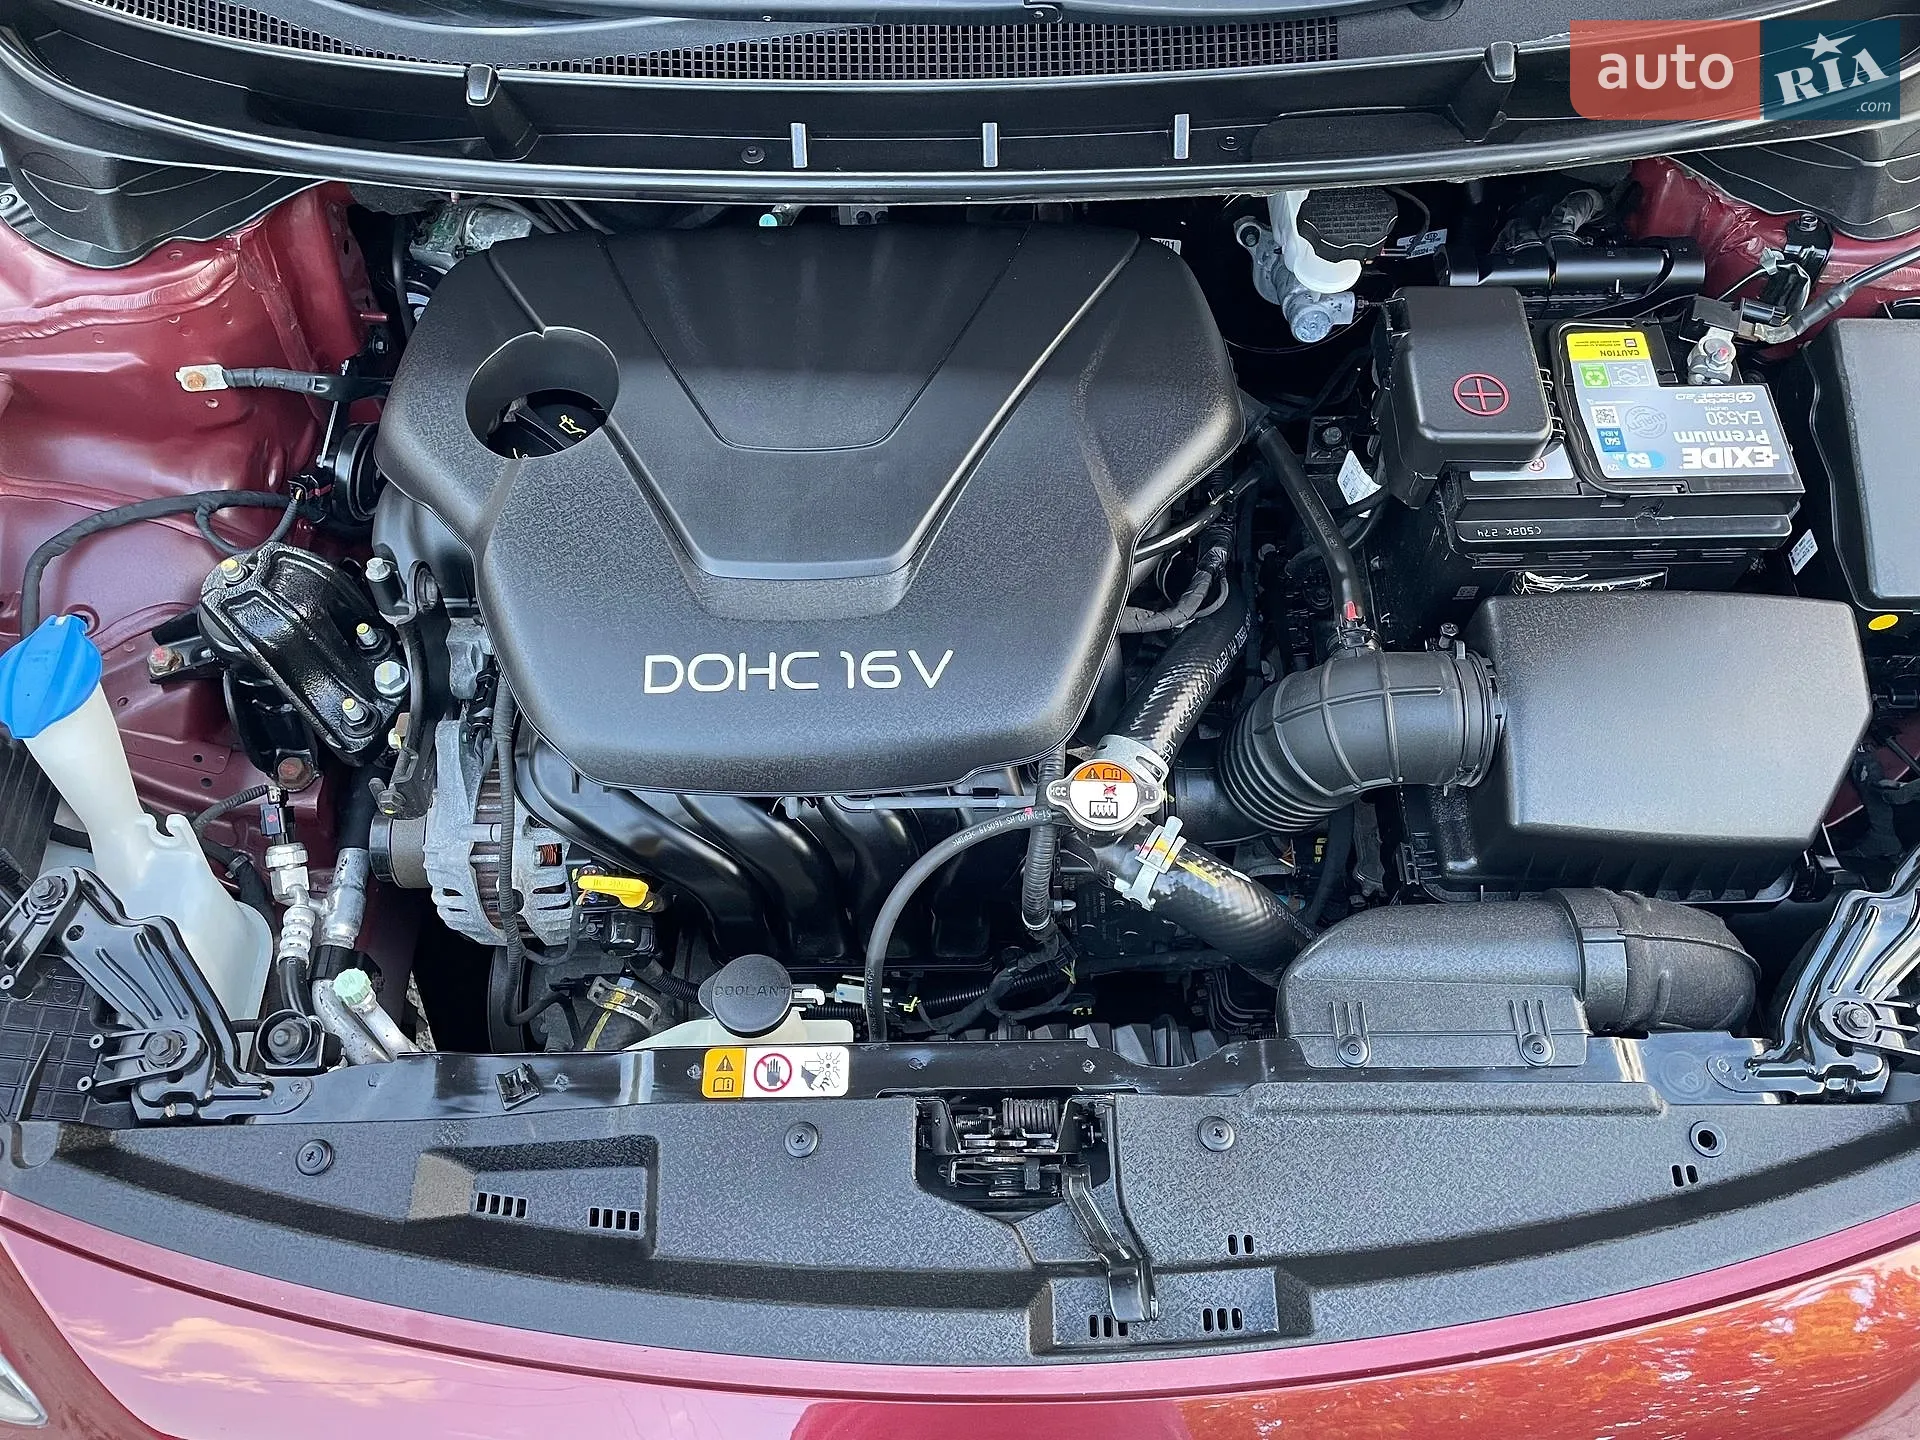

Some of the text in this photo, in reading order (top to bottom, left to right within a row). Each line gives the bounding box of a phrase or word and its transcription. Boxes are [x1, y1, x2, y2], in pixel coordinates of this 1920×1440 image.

[1599, 349, 1641, 357] CAUTION
[1706, 411, 1763, 425] EA530
[1673, 429, 1771, 446] Premium
[1625, 452, 1652, 469] 53
[1682, 446, 1779, 470] EXIDE
[643, 651, 820, 694] DOHC
[710, 984, 790, 999] COOLANT
